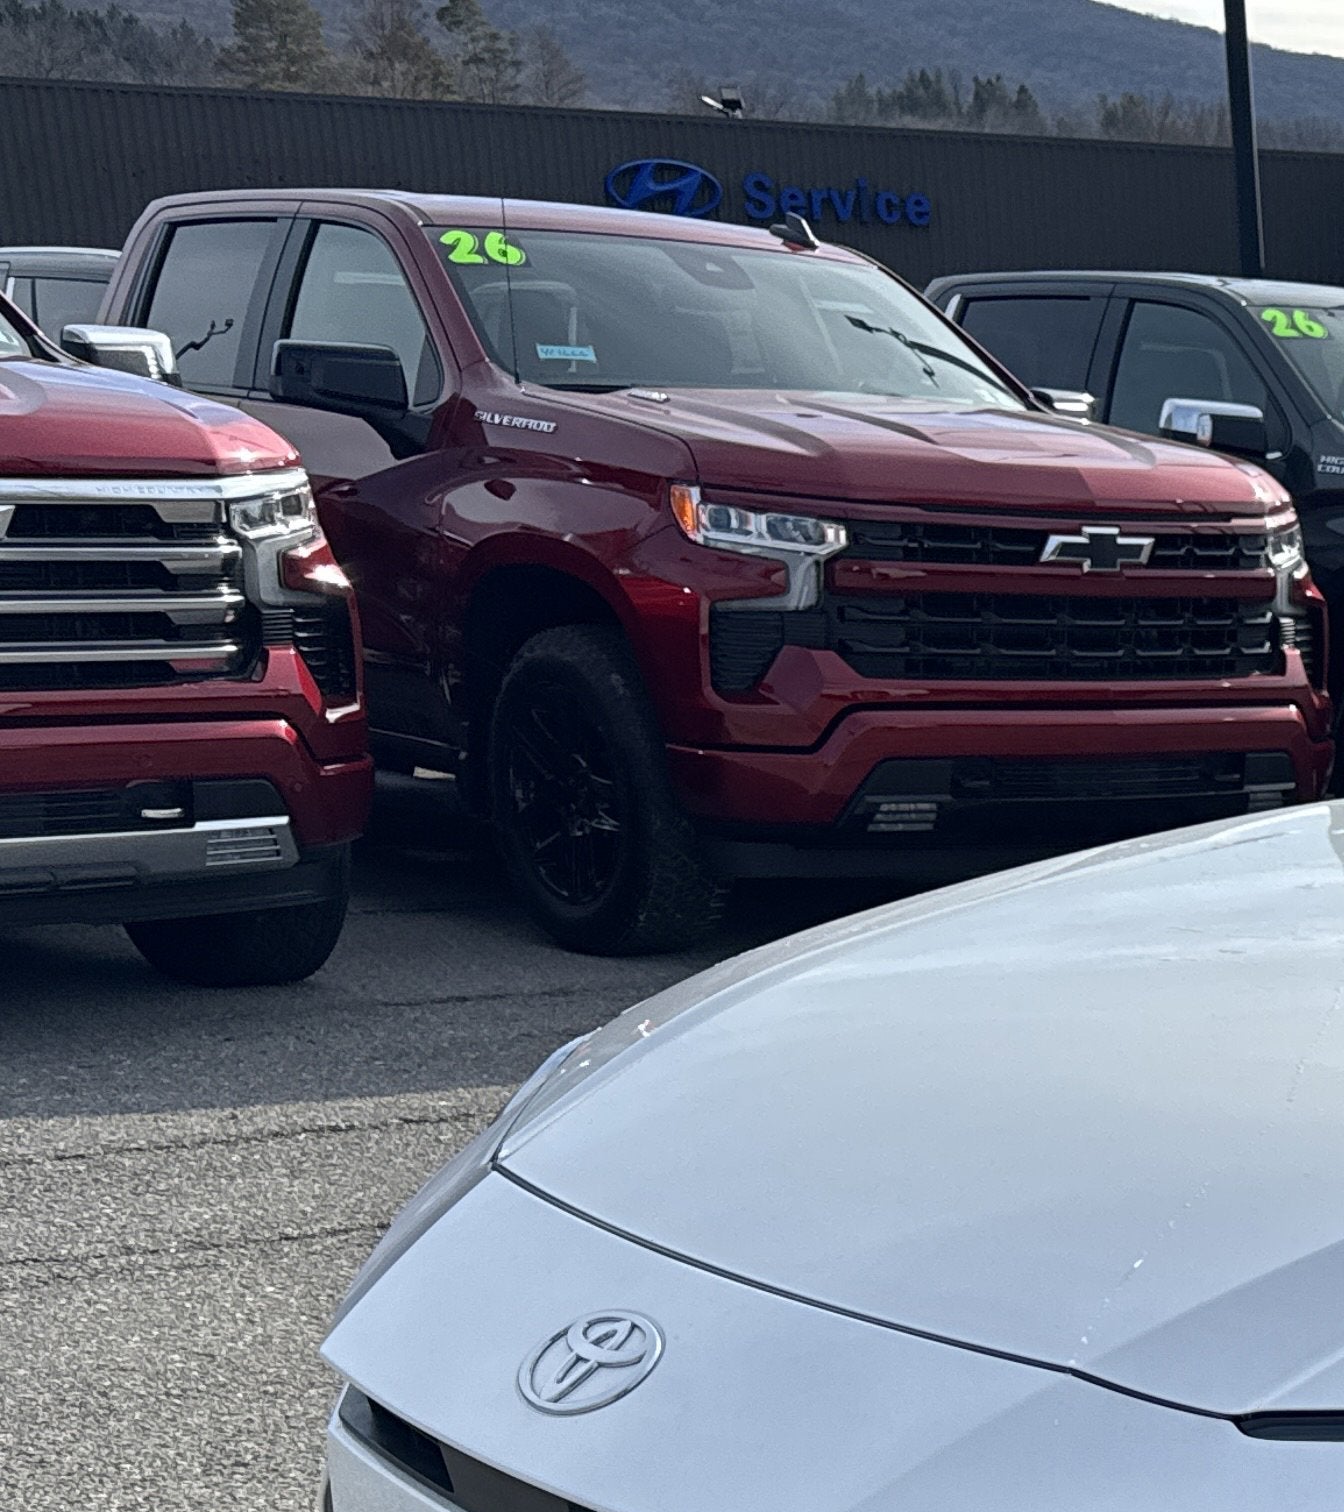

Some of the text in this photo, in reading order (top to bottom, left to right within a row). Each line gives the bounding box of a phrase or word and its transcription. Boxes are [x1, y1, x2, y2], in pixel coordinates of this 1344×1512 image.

[743, 171, 931, 226] Service
[439, 229, 526, 266] 26
[1261, 308, 1328, 339] 26
